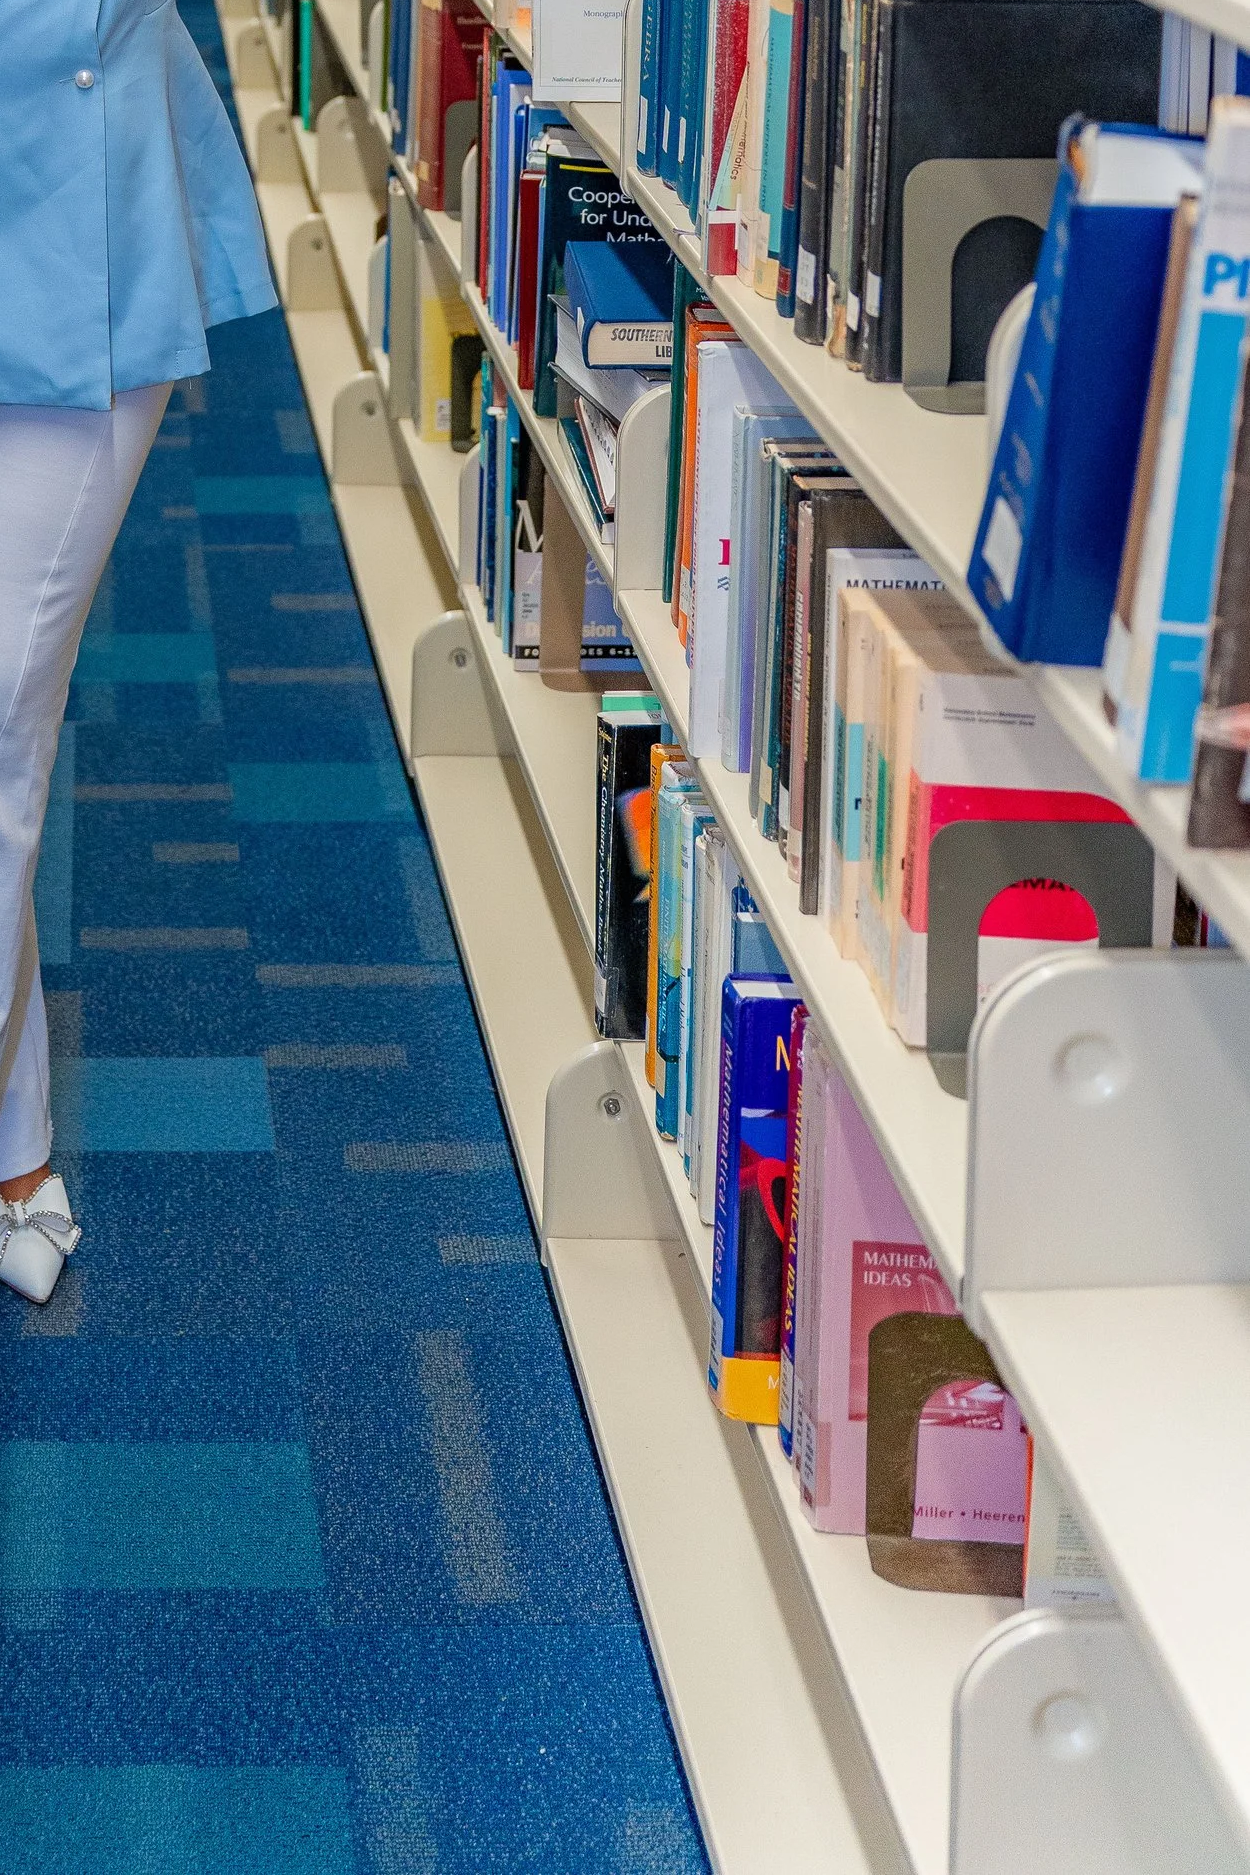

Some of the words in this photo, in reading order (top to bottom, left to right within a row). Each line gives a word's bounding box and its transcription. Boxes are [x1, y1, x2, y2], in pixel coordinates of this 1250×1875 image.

[580, 208, 607, 225] for
[611, 328, 673, 342] SOUTHERN
[794, 591, 805, 680] COMPANION
[601, 754, 609, 782] The
[598, 786, 608, 861] Chemistry
[598, 866, 606, 914] Maths
[718, 1042, 734, 1212] Mathematical
[788, 1083, 804, 1256] MATHEMATICAL
[714, 1221, 728, 1287] Ideas
[863, 1271, 912, 1287] IDEAS
[783, 1265, 796, 1332] IDEAS
[912, 1504, 953, 1518] Miller
[973, 1510, 1025, 1522] Heeren
